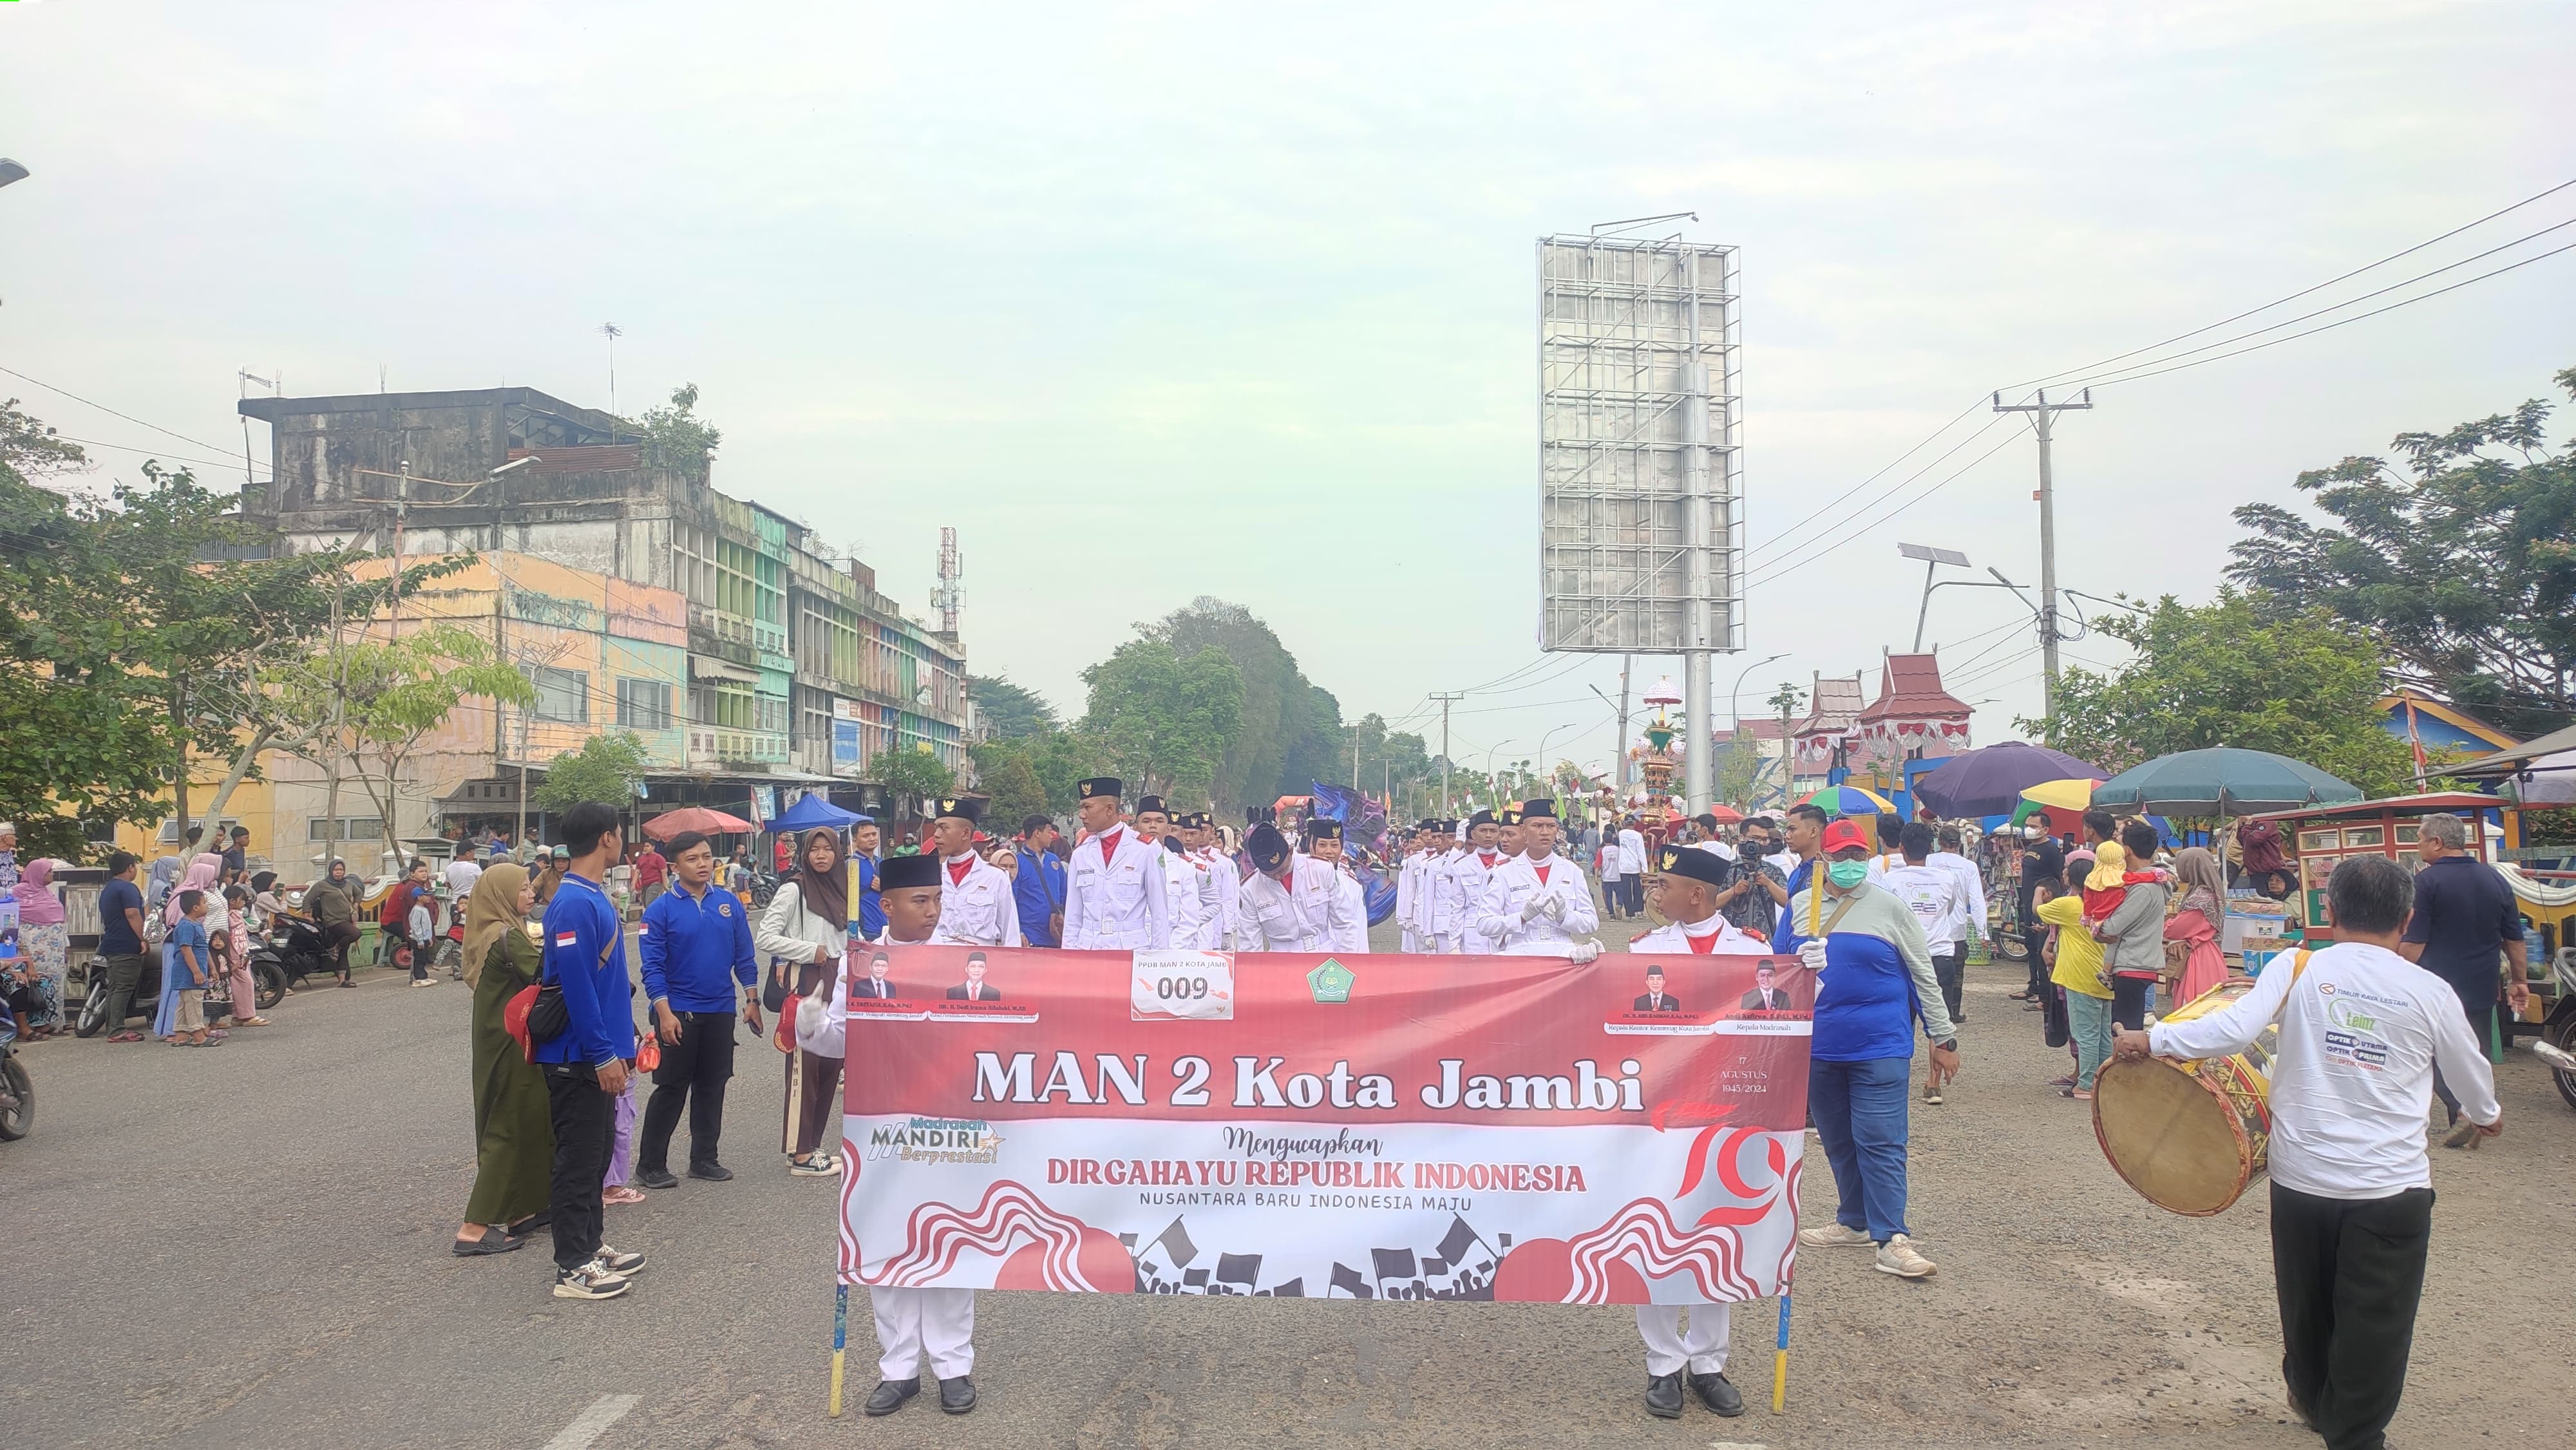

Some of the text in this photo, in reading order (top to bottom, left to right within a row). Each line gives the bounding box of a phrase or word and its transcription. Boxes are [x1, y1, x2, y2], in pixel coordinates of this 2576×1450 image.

[1157, 977, 1208, 999] 009
[2337, 988, 2360, 998] TIMUR
[2380, 997, 2408, 1008] LESTARI
[1737, 1024, 1758, 1032] Kepala
[2327, 1034, 2351, 1044] OPTIK
[2326, 1046, 2350, 1056] OPTIK
[2358, 1052, 2385, 1062] PRIMA
[972, 1051, 1645, 1112] MAN 2 Kota Jambi
[1720, 1070, 1767, 1079] AGUSTUS
[1722, 1084, 1767, 1093] 1945/2024
[910, 1117, 987, 1131] Madrasah
[871, 1128, 980, 1149] MANDIRI
[1224, 1127, 1383, 1161] Mengucapkan
[901, 1146, 998, 1165] Berprestasi
[1047, 1158, 1587, 1192] DIRGAHAYU REPUBLIK INDONESIA
[1140, 1192, 1471, 1211] NUSANTARA BARU INDONESIA MAJU
